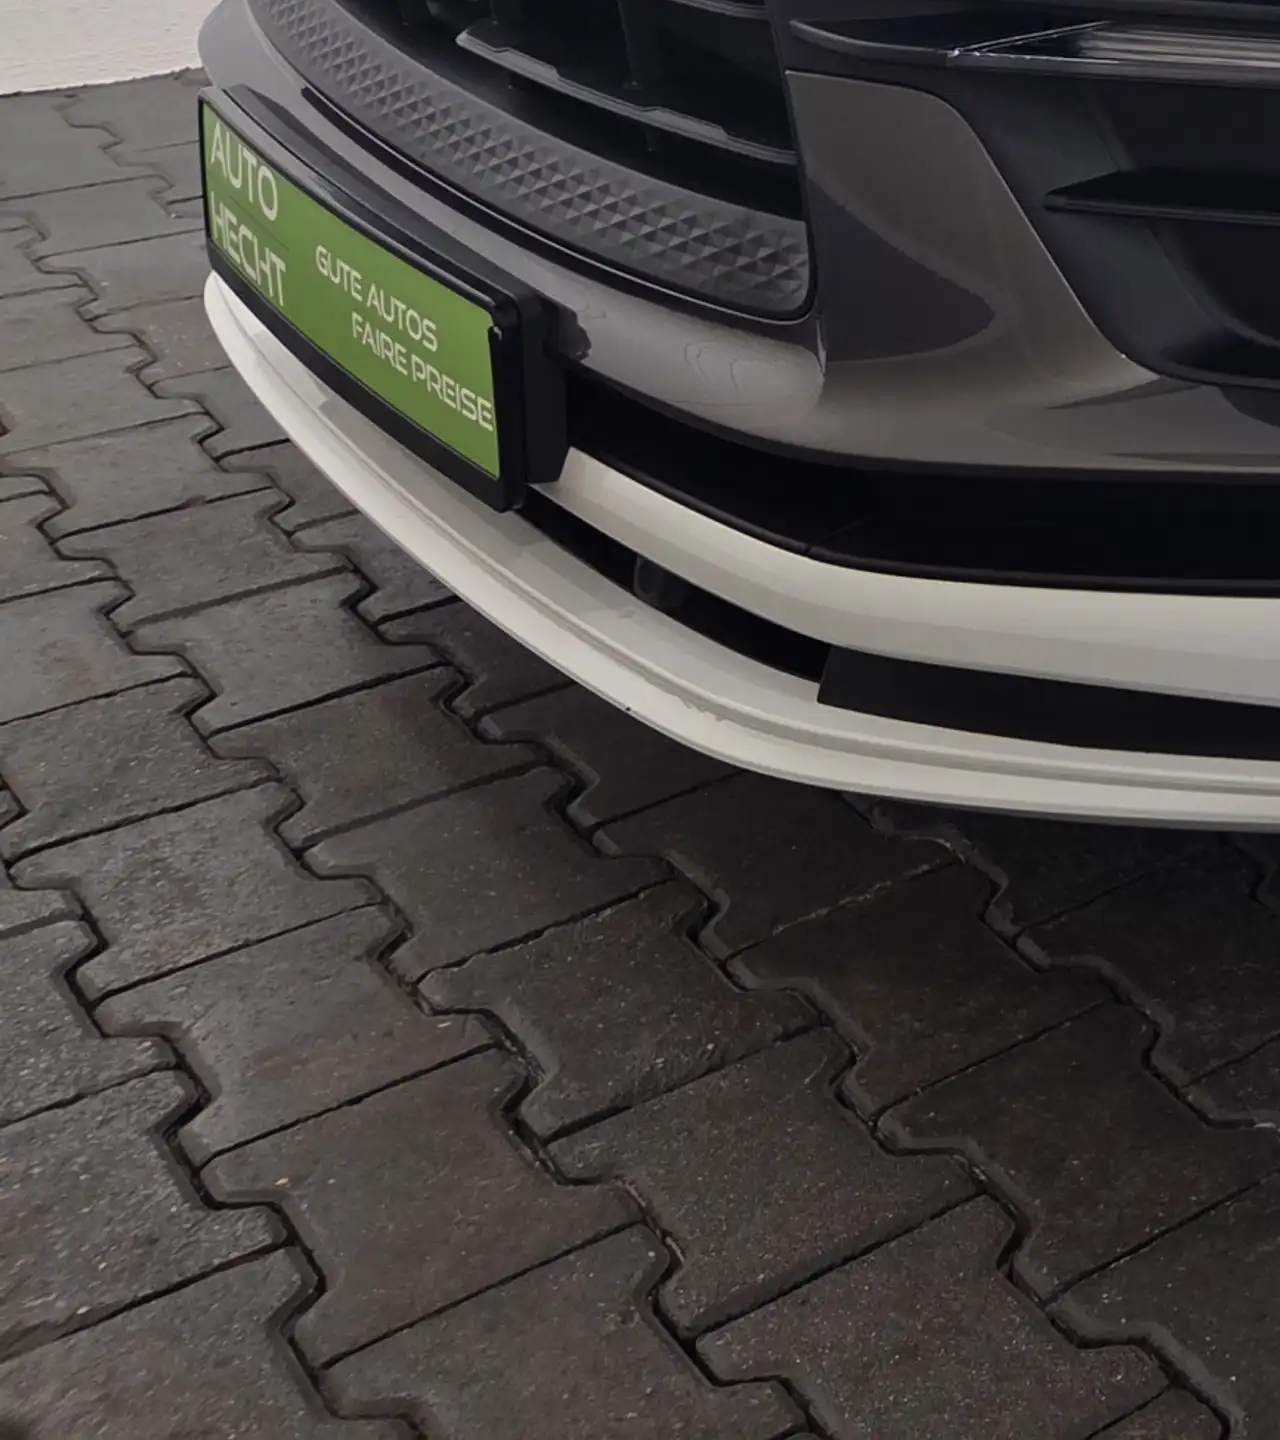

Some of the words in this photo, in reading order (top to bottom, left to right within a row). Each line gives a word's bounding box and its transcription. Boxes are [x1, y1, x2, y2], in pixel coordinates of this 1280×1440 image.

[210, 122, 278, 221] AUTO
[210, 192, 286, 307] HECHT
[315, 244, 363, 302] GUTE
[366, 283, 437, 352] AUTOS
[352, 311, 408, 376] FAIRE
[412, 357, 493, 431] PREISE
